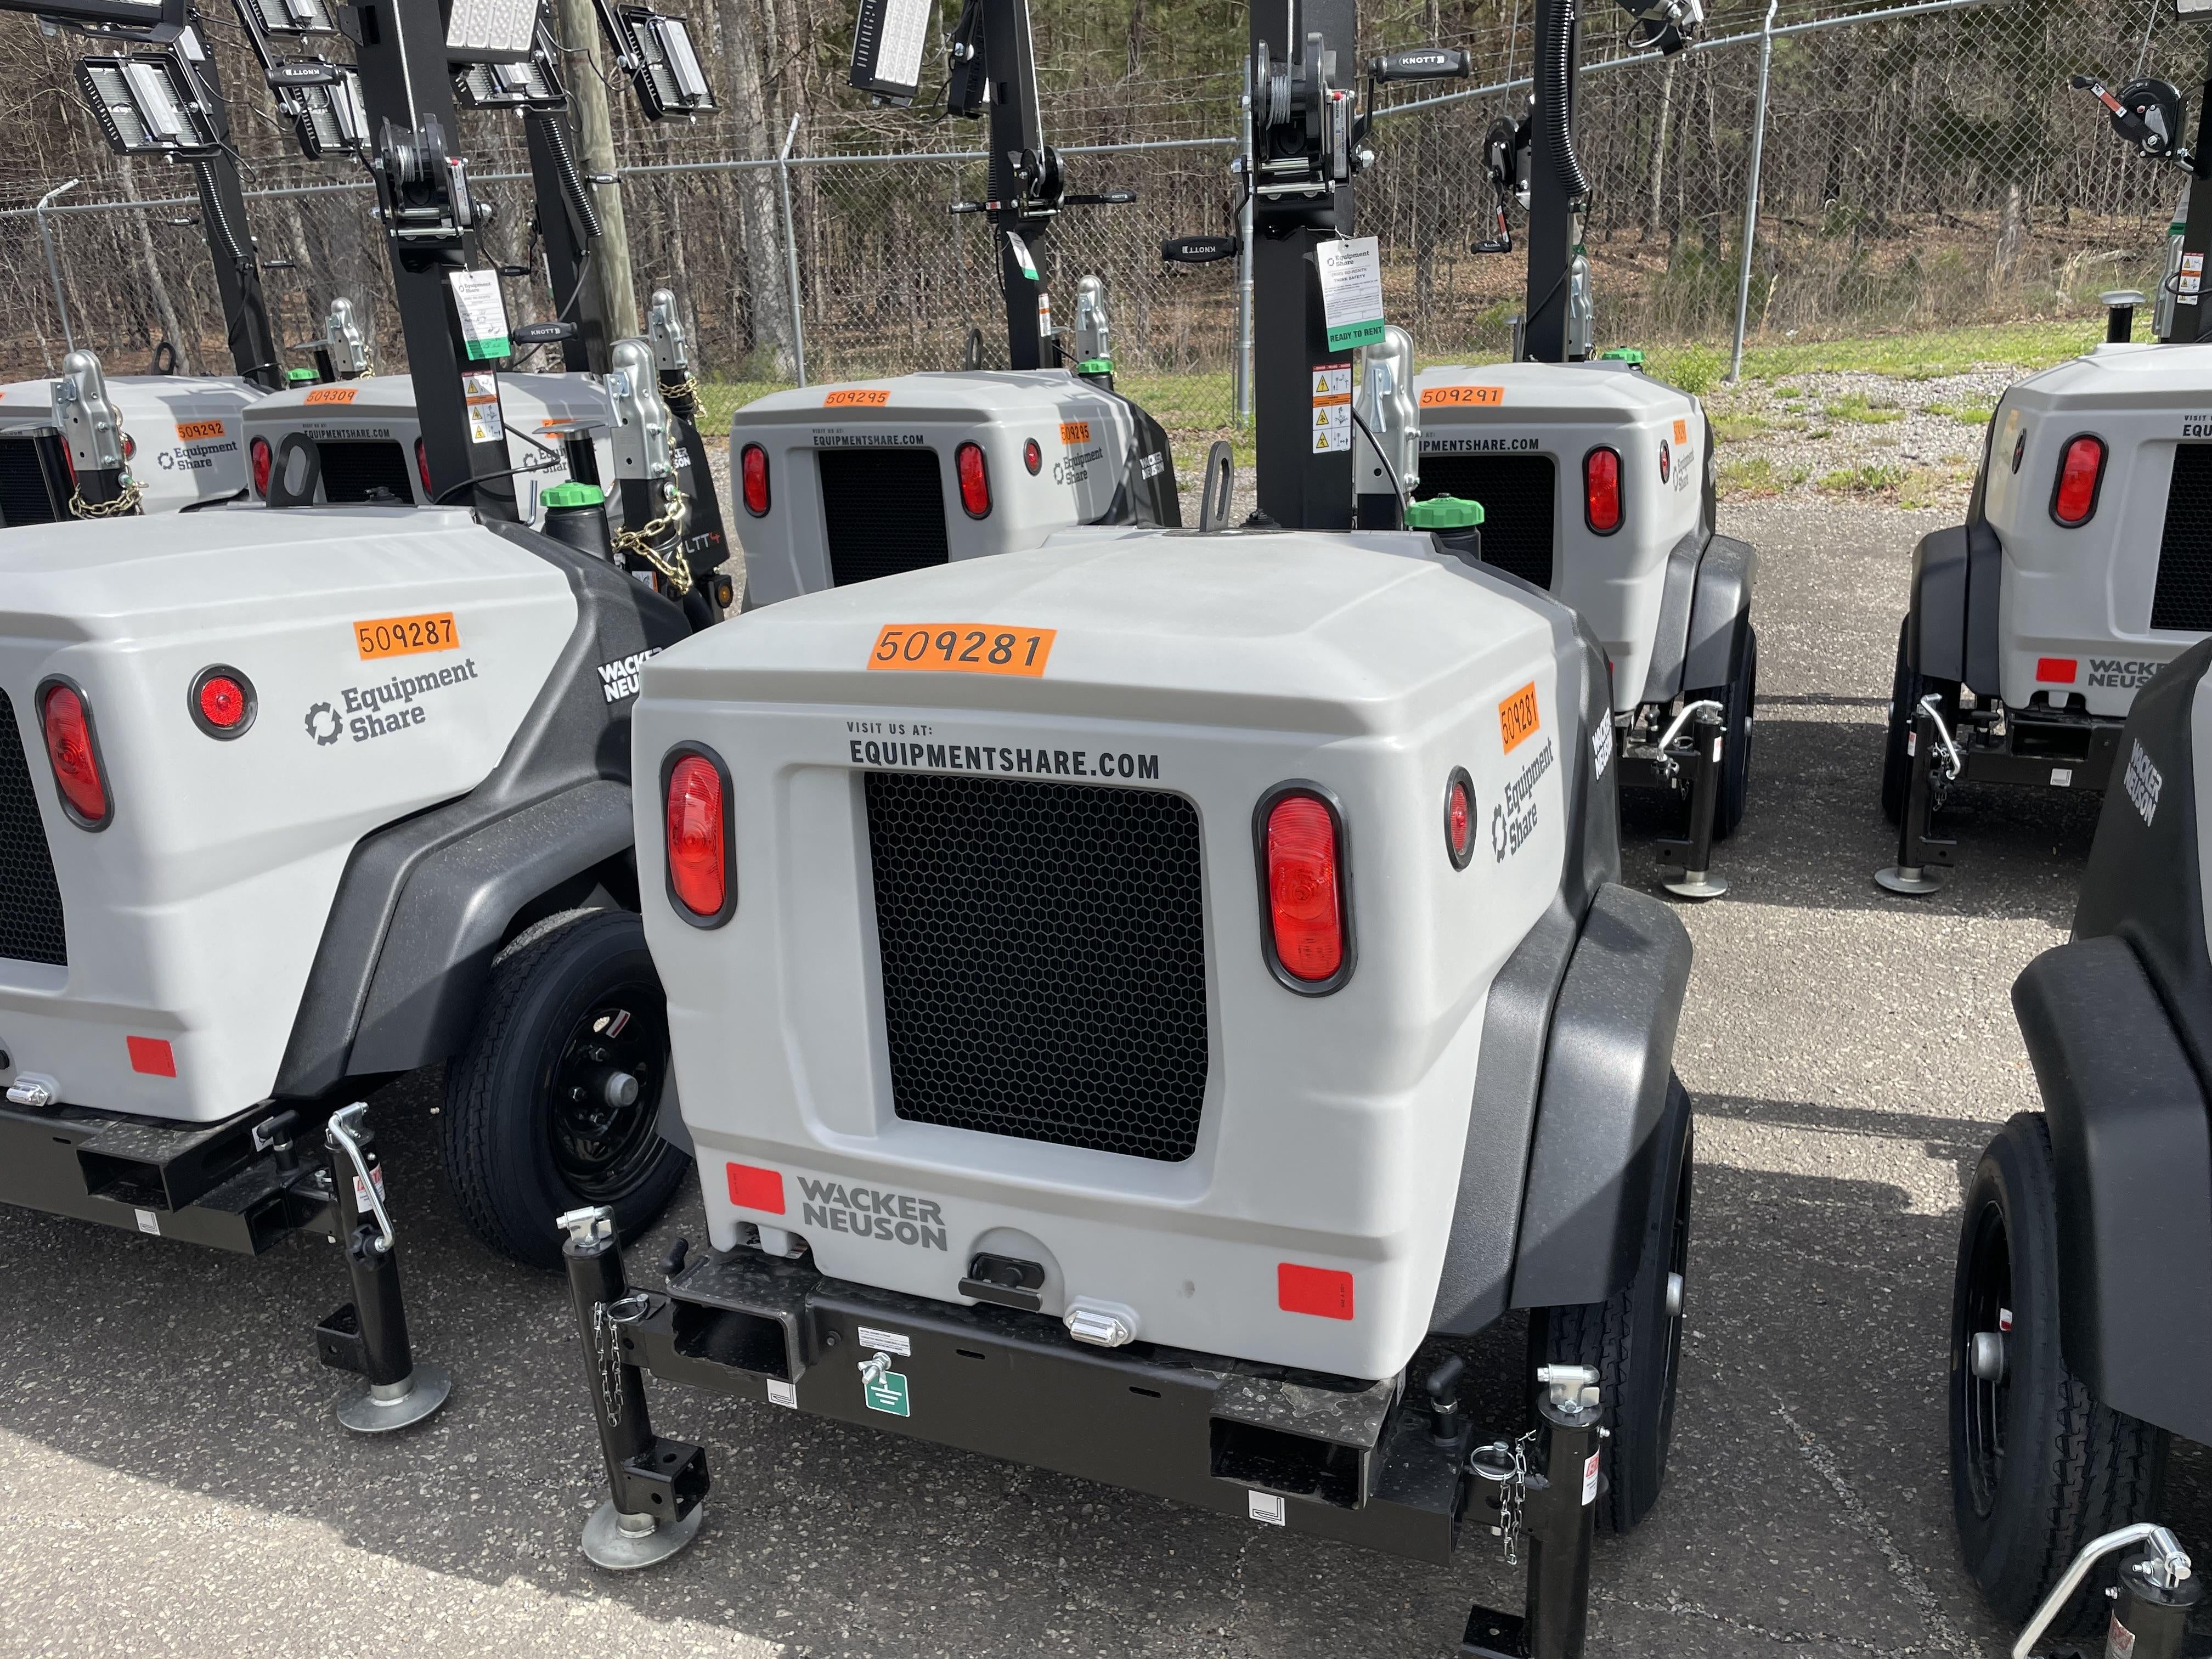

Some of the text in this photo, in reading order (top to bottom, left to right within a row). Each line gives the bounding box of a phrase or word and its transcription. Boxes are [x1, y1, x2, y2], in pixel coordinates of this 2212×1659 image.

[1402, 56, 1436, 64] KNOTT
[1335, 251, 1370, 261] Equipment
[1330, 331, 1352, 343] READY
[1364, 326, 1383, 336] RENT
[307, 391, 356, 402] 509309
[826, 392, 887, 404] 509295
[1422, 389, 1498, 403] 509291
[178, 422, 224, 438] 509292
[304, 429, 390, 439] EQUIPMENTSHARE.COM
[1062, 425, 1089, 441] 509295
[813, 435, 924, 445] EQUIPMENTSHARE.COM
[1419, 438, 1539, 452] IPMENTSHARE.COM
[174, 441, 238, 460] Equipment
[1063, 447, 1103, 470] Equipment
[177, 458, 212, 471] Share
[1066, 469, 1088, 485] Share
[359, 619, 452, 653] 509287
[876, 630, 1041, 666] 509281
[341, 658, 478, 714] Equipment
[603, 674, 640, 702] NEU
[2088, 673, 2149, 689] NEUS
[350, 706, 426, 742] Share
[1502, 691, 1537, 745] 509281
[847, 721, 933, 736] VISIT US AT:
[850, 740, 1159, 780] EQUIPMENTSHARE.COM
[1504, 736, 1554, 818] Equipment
[2131, 738, 2162, 803] WACKER
[2124, 762, 2156, 827] NEUSON
[1509, 803, 1538, 856] Share
[796, 1176, 946, 1226] WACKER
[803, 1202, 948, 1251] NEUSON
